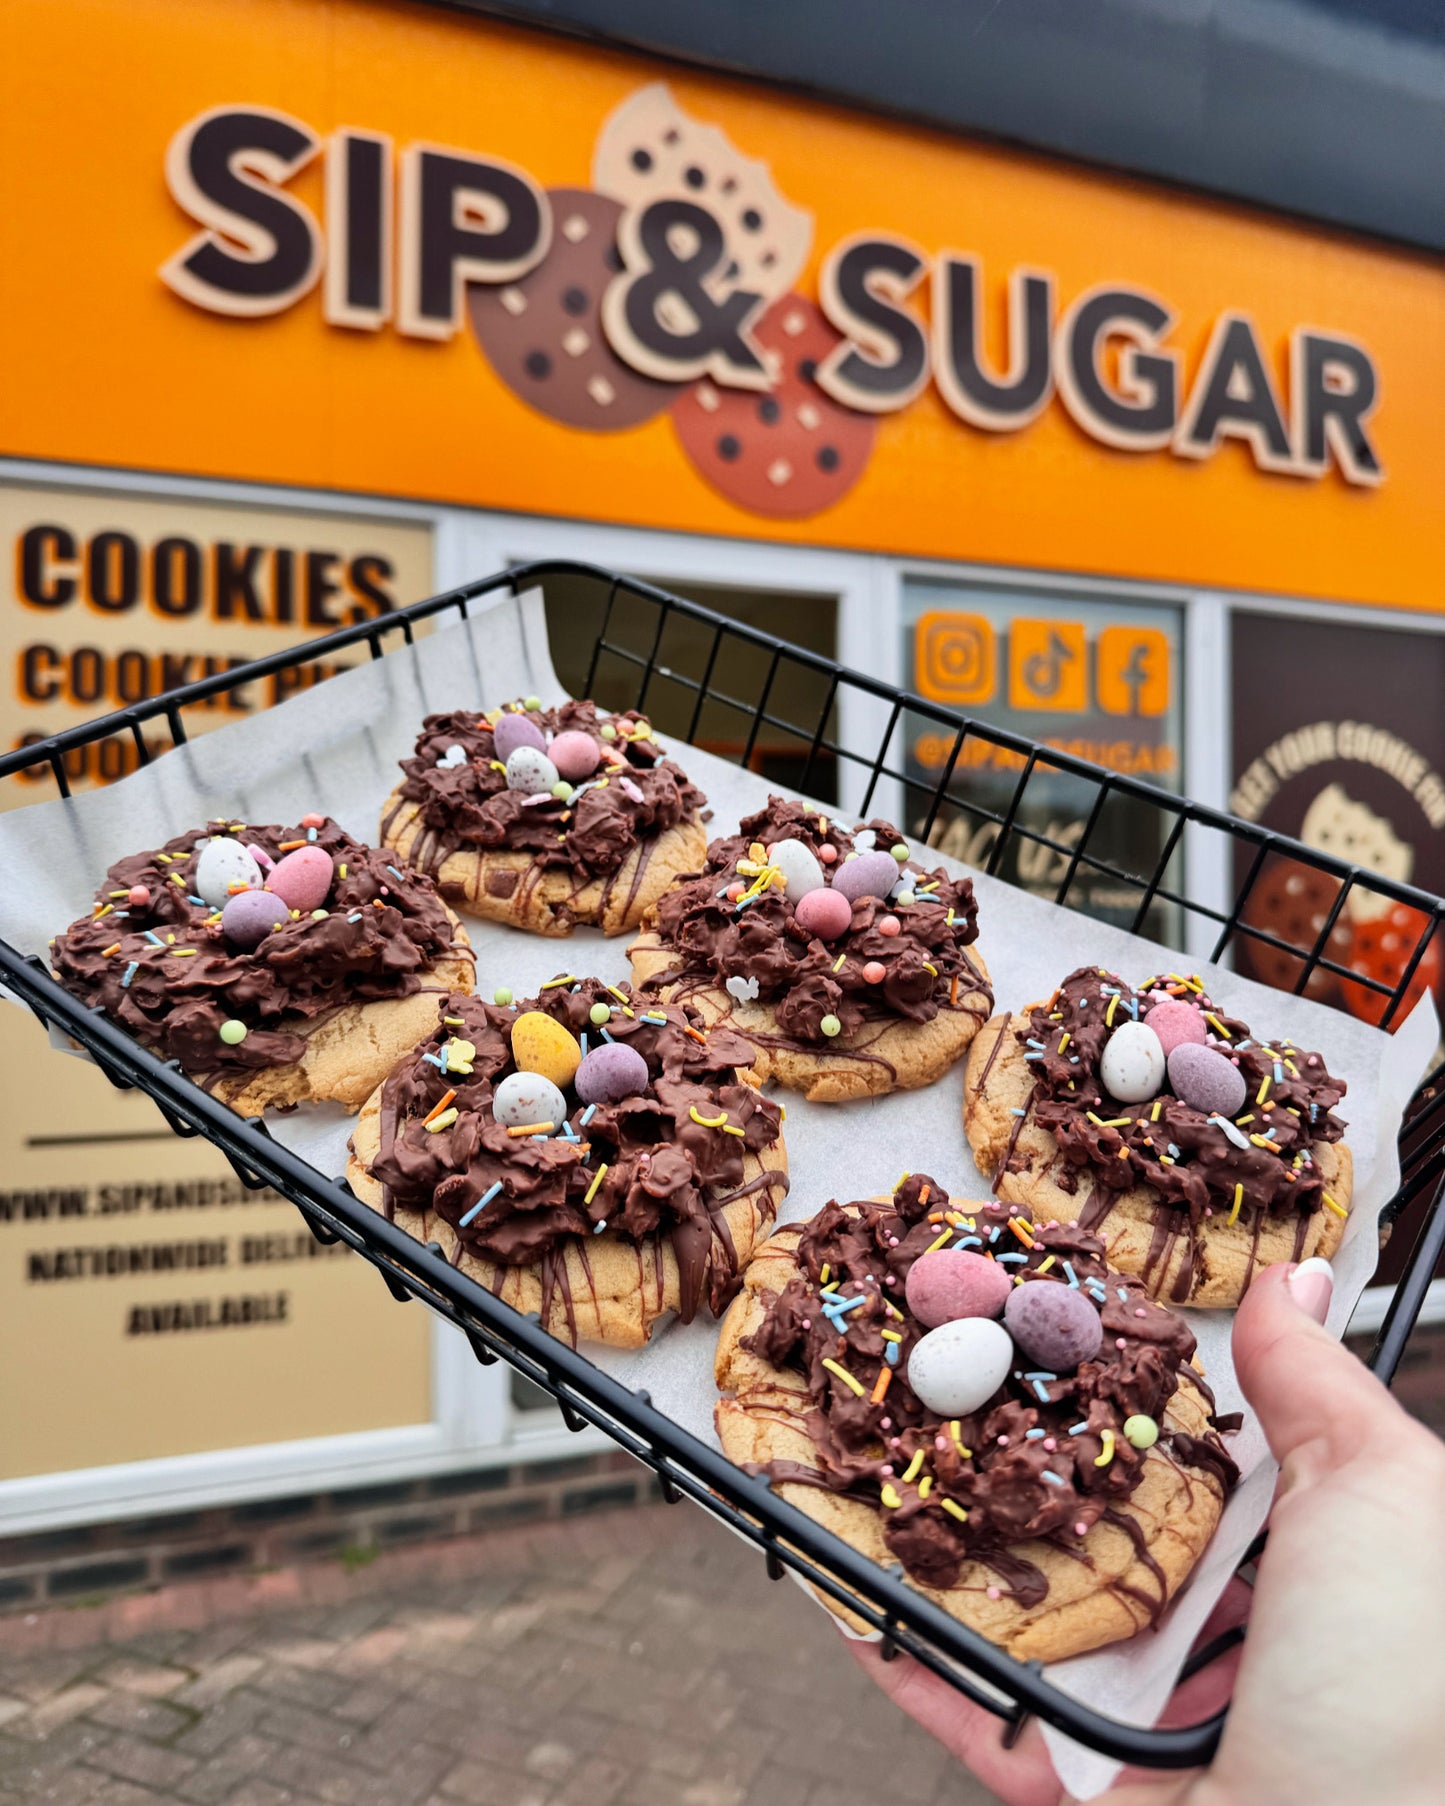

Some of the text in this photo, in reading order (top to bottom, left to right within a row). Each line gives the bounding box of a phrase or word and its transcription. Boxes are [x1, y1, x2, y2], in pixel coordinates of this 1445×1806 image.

[158, 103, 1386, 488] SIP & SUGAR
[16, 524, 396, 630] COOKIES
[27, 1237, 228, 1281] NATIONWIDE
[128, 1292, 288, 1335] AVAILABLE
